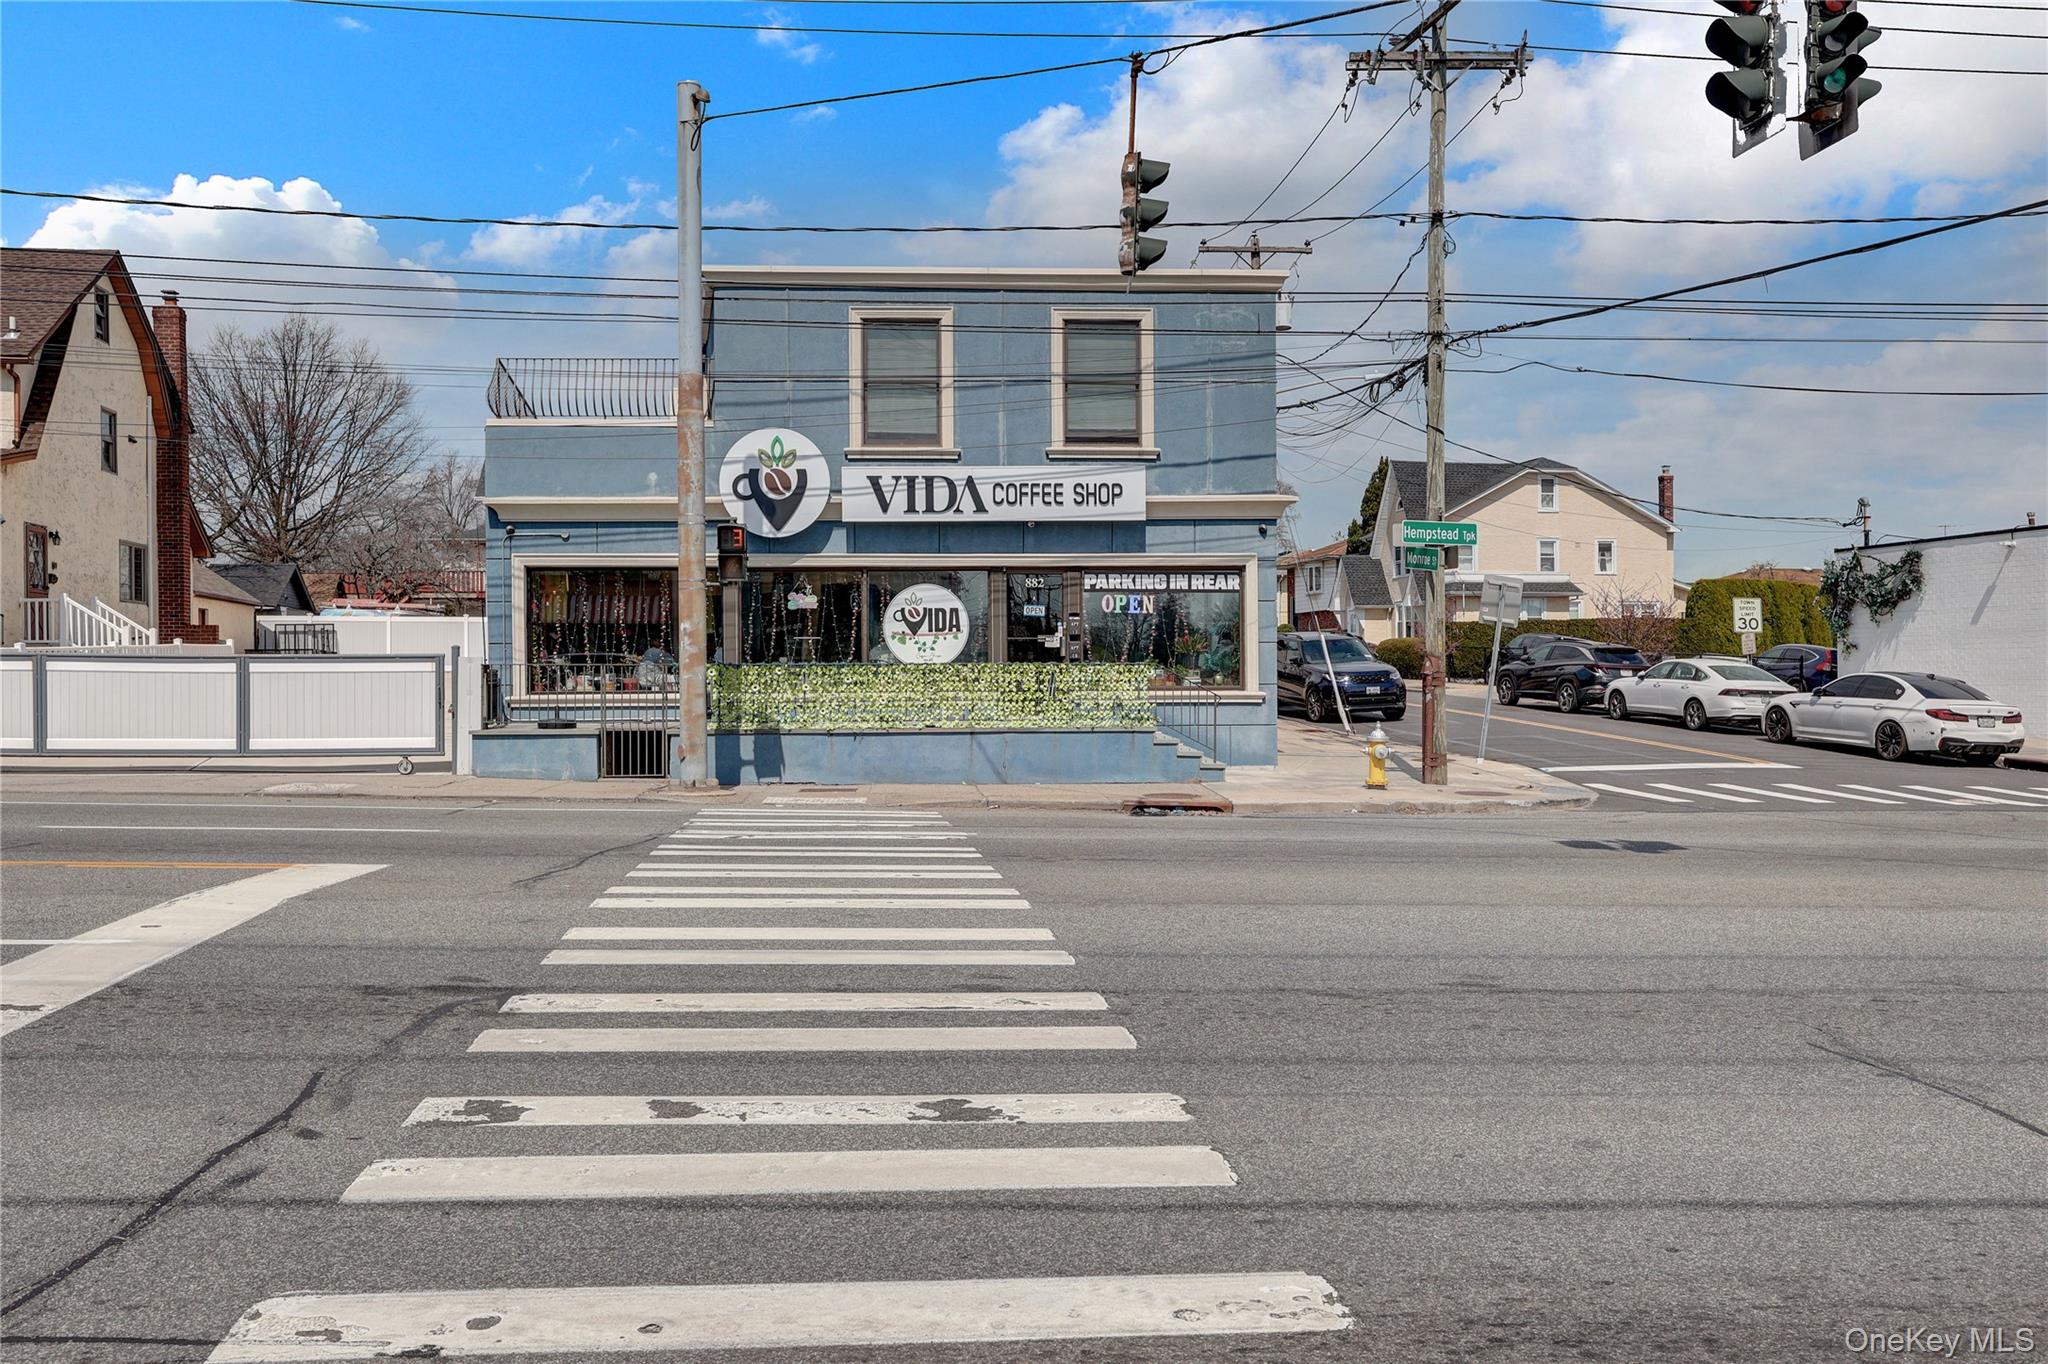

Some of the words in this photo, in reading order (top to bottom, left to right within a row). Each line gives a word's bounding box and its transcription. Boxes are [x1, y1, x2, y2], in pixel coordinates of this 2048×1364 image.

[866, 475, 989, 515] VIDA
[992, 483, 1064, 507] COFFEE
[1073, 483, 1123, 507] SHOP
[1403, 525, 1459, 542] Hempstead
[1462, 530, 1476, 542] Tpk
[1406, 551, 1431, 566] Monroe
[1025, 578, 1045, 588] 882
[1084, 573, 1167, 590] PARKING
[1169, 573, 1189, 590] IN
[1191, 574, 1240, 590] REAR
[1025, 606, 1044, 615] OPEN
[1101, 594, 1155, 615] OPEN
[894, 607, 961, 636] VIDA
[1738, 617, 1759, 630] 30
